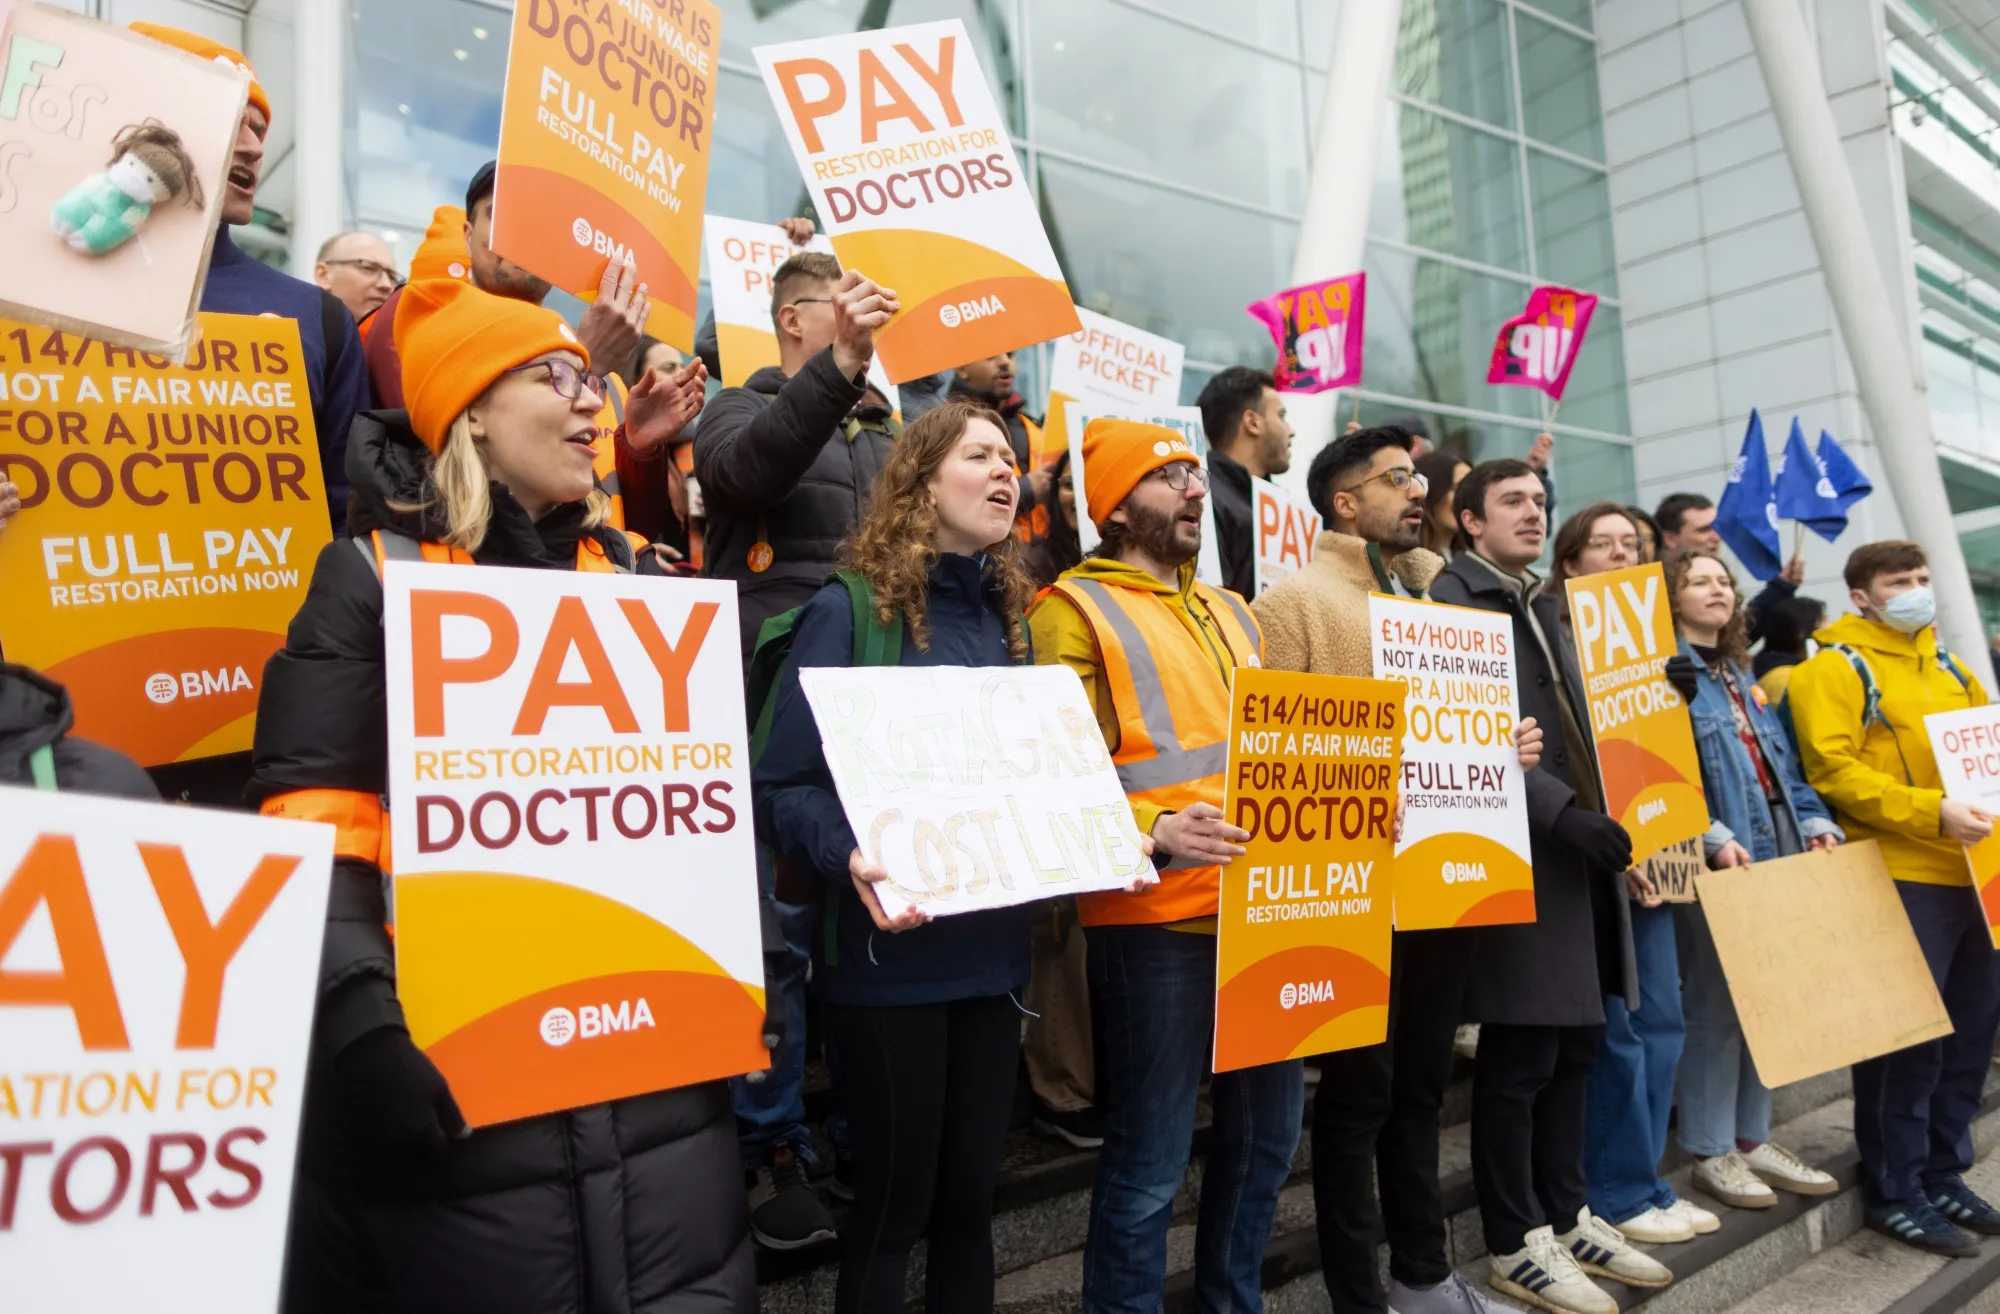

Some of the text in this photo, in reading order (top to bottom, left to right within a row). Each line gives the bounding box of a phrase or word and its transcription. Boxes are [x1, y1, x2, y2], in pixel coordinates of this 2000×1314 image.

[657, 16, 709, 76] WAGE
[691, 10, 712, 48] IS
[596, 3, 614, 36] A
[618, 18, 707, 105] JUNIOR
[528, 0, 704, 152] DOCTOR
[772, 36, 965, 154] PAY
[540, 65, 685, 191] FULL PAY
[537, 105, 682, 214] RESTORATION NOW
[812, 128, 999, 180] RESTORATION FOR
[824, 153, 1013, 223] DOCTORS
[594, 229, 636, 268] BMA
[959, 294, 1006, 323] BMA
[251, 341, 289, 374] IS
[1078, 350, 1159, 394] PICKET
[76, 375, 104, 404] A
[112, 377, 193, 405] FAIR
[198, 380, 296, 408] WAGE
[103, 412, 137, 445] A
[146, 414, 302, 452] JUNIOR
[0, 452, 312, 510] DOCTOR
[1259, 492, 1318, 569] PAY
[41, 527, 293, 581] FULL PAY
[49, 569, 299, 607] RESTORATION NOW
[1382, 618, 1507, 656] £14/HOUR IS
[1574, 575, 1658, 673] PAY
[181, 666, 254, 698] BMA
[409, 589, 721, 737] PAY
[1382, 648, 1509, 679] NOT A FAIR WAGE
[1588, 660, 1650, 695] RESTORATION
[1243, 693, 1395, 730] £14/HOUR IS
[1429, 679, 1443, 701] A
[1445, 679, 1511, 707] JUNIOR
[1593, 680, 1681, 733] DOCTORS
[1240, 731, 1393, 759] NOT A FAIR WAGE
[1400, 704, 1513, 747] OCTOR
[414, 743, 733, 781] RESTORATION FOR
[1237, 761, 1391, 796] FOR A JUNIOR
[1404, 761, 1505, 791] FULL PAY
[1961, 751, 2000, 781] PIC
[417, 780, 736, 853] DOCTORS
[1236, 796, 1387, 844] DOCTOR
[1407, 793, 1508, 809] RESTORATION NOW
[869, 795, 1151, 904] COST LIVES
[1247, 861, 1374, 901] FULL PAY
[1456, 862, 1487, 882] BMA
[1246, 897, 1371, 924] RESTORATION NOW
[1298, 979, 1335, 1006] BMA
[580, 998, 655, 1038] BMA
[174, 1066, 278, 1112] FOR
